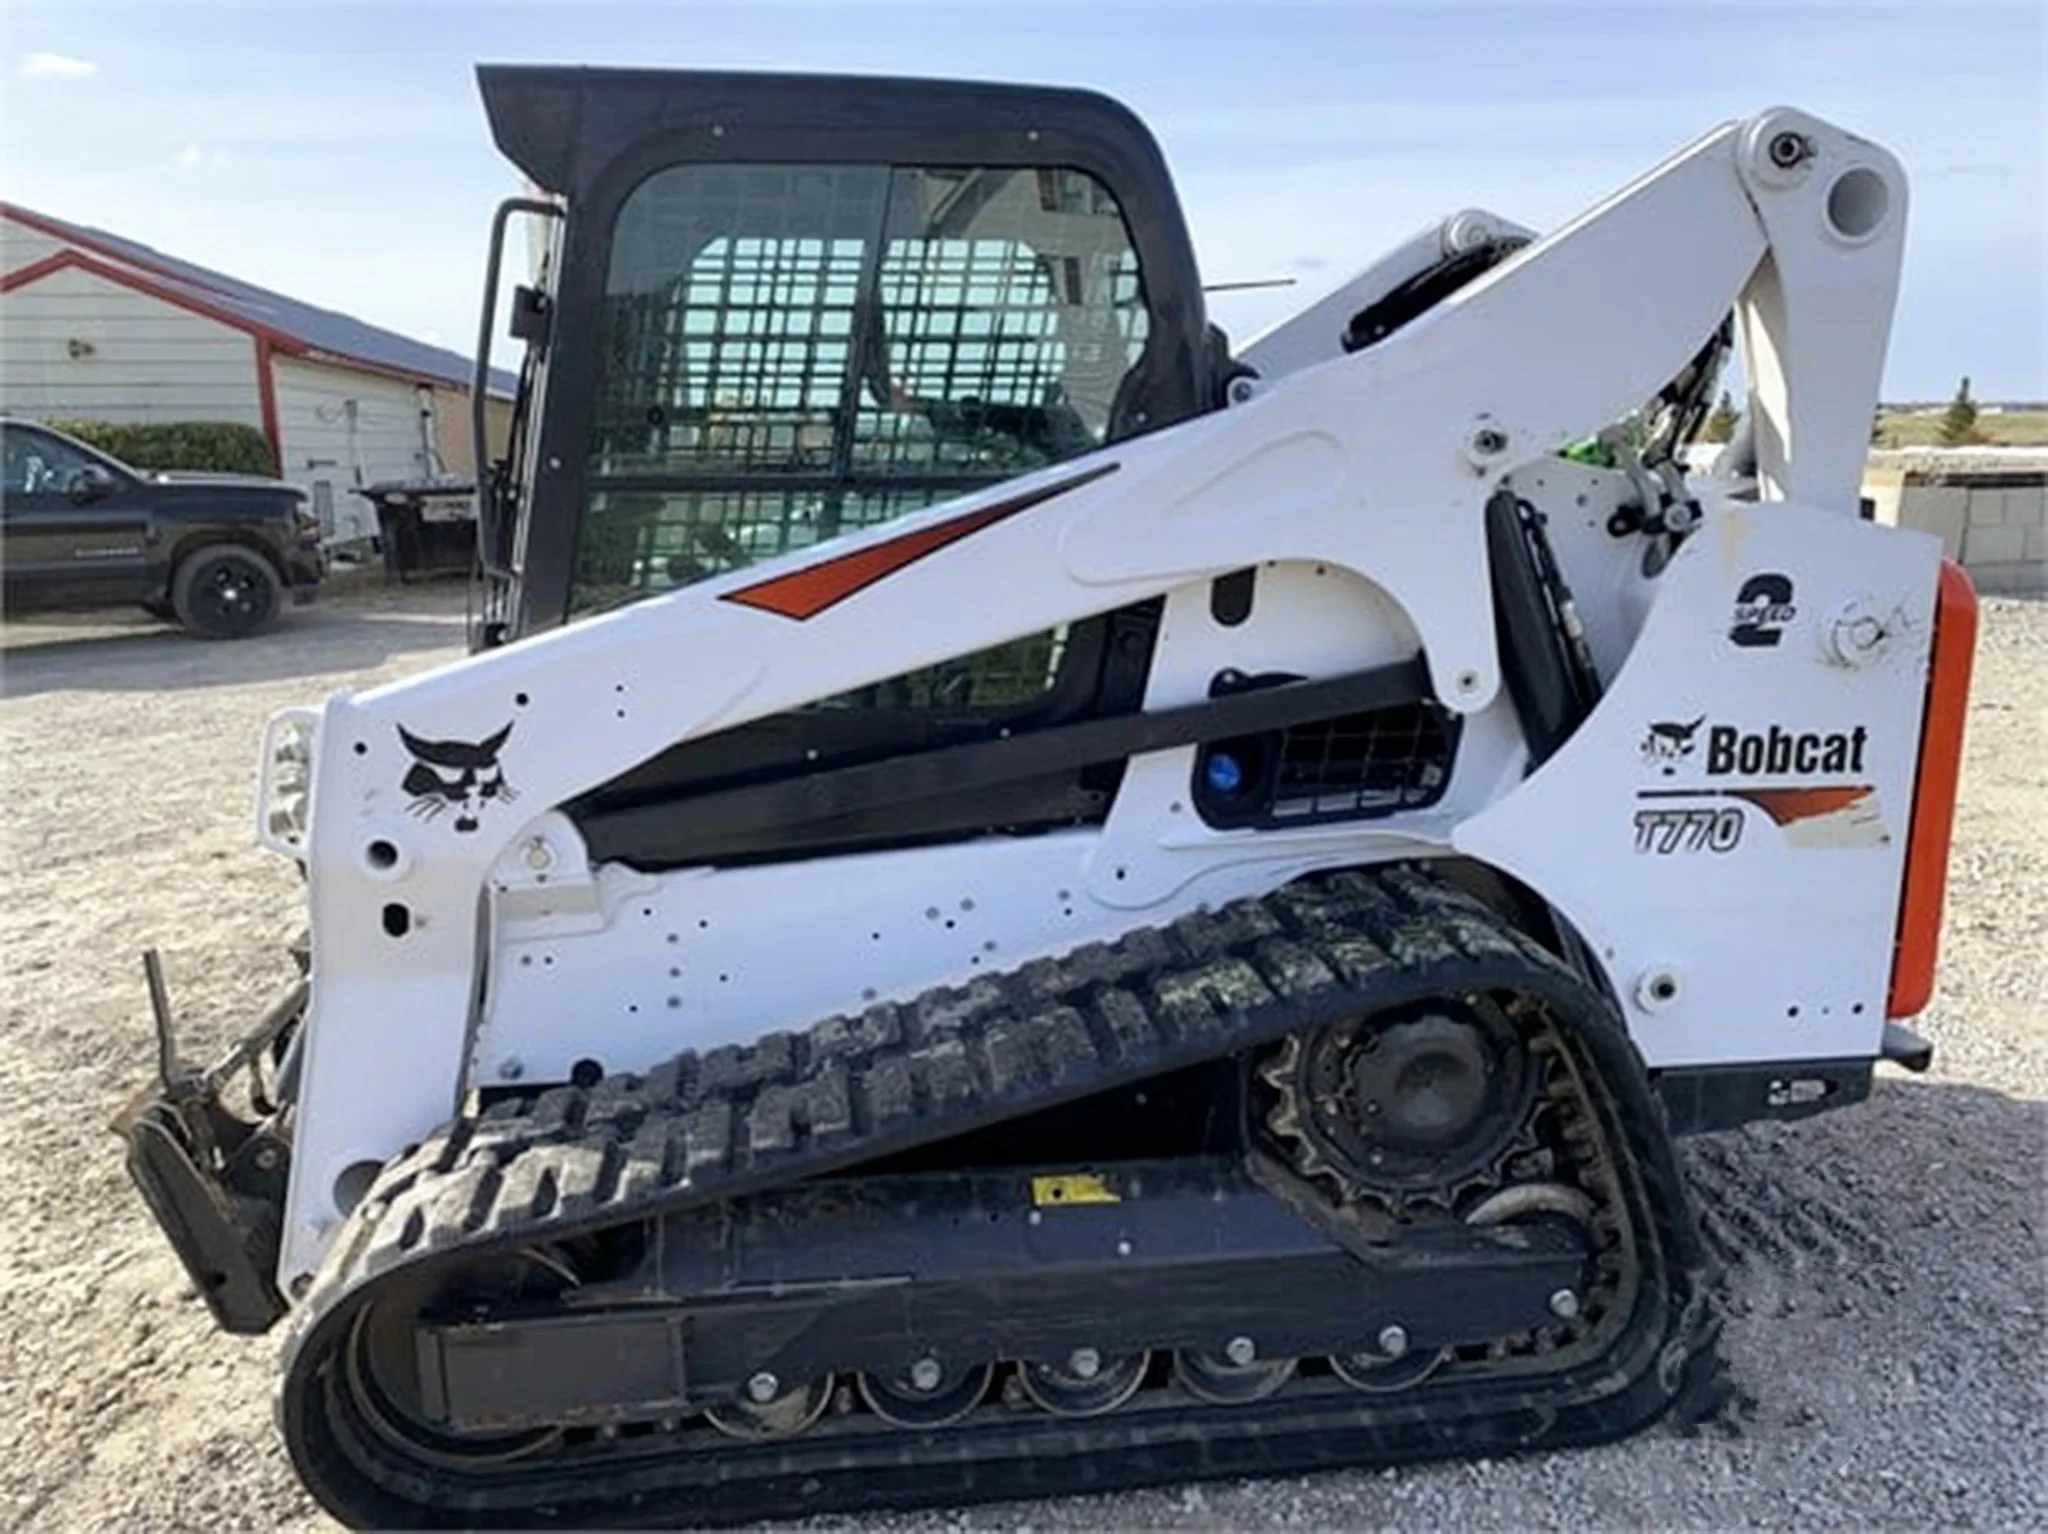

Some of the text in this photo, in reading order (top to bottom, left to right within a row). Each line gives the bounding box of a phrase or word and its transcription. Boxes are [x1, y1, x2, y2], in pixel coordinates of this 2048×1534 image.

[1729, 573, 1794, 647] 2
[1707, 725, 1868, 775] Bobcat
[1634, 808, 1745, 854] T770
